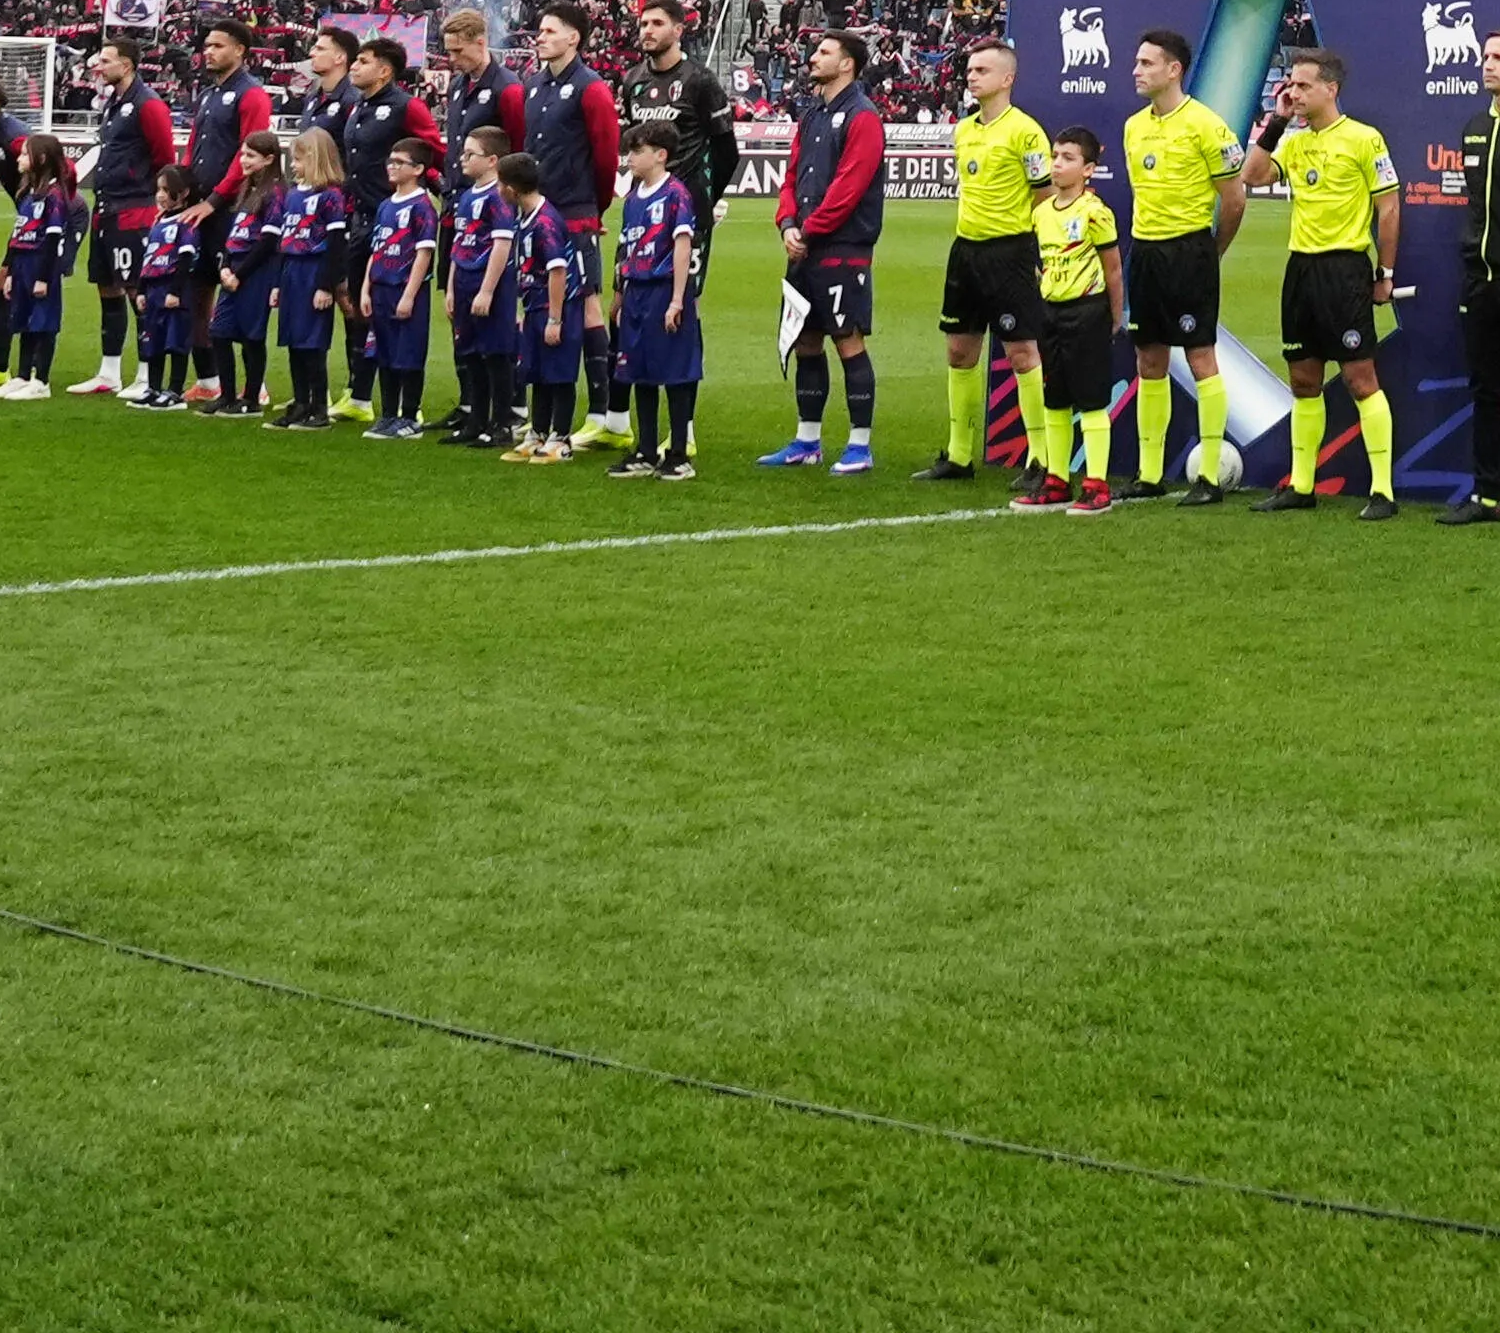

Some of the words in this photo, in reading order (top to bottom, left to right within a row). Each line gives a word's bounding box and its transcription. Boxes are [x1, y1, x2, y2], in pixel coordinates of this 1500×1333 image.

[1061, 77, 1107, 95] enilive
[1425, 76, 1479, 95] enilive
[631, 103, 681, 122] Saputo
[1221, 143, 1241, 158] NET
[1427, 144, 1465, 171] Una
[906, 158, 938, 180] DEI
[113, 247, 133, 271] 10
[828, 284, 844, 314] 7
